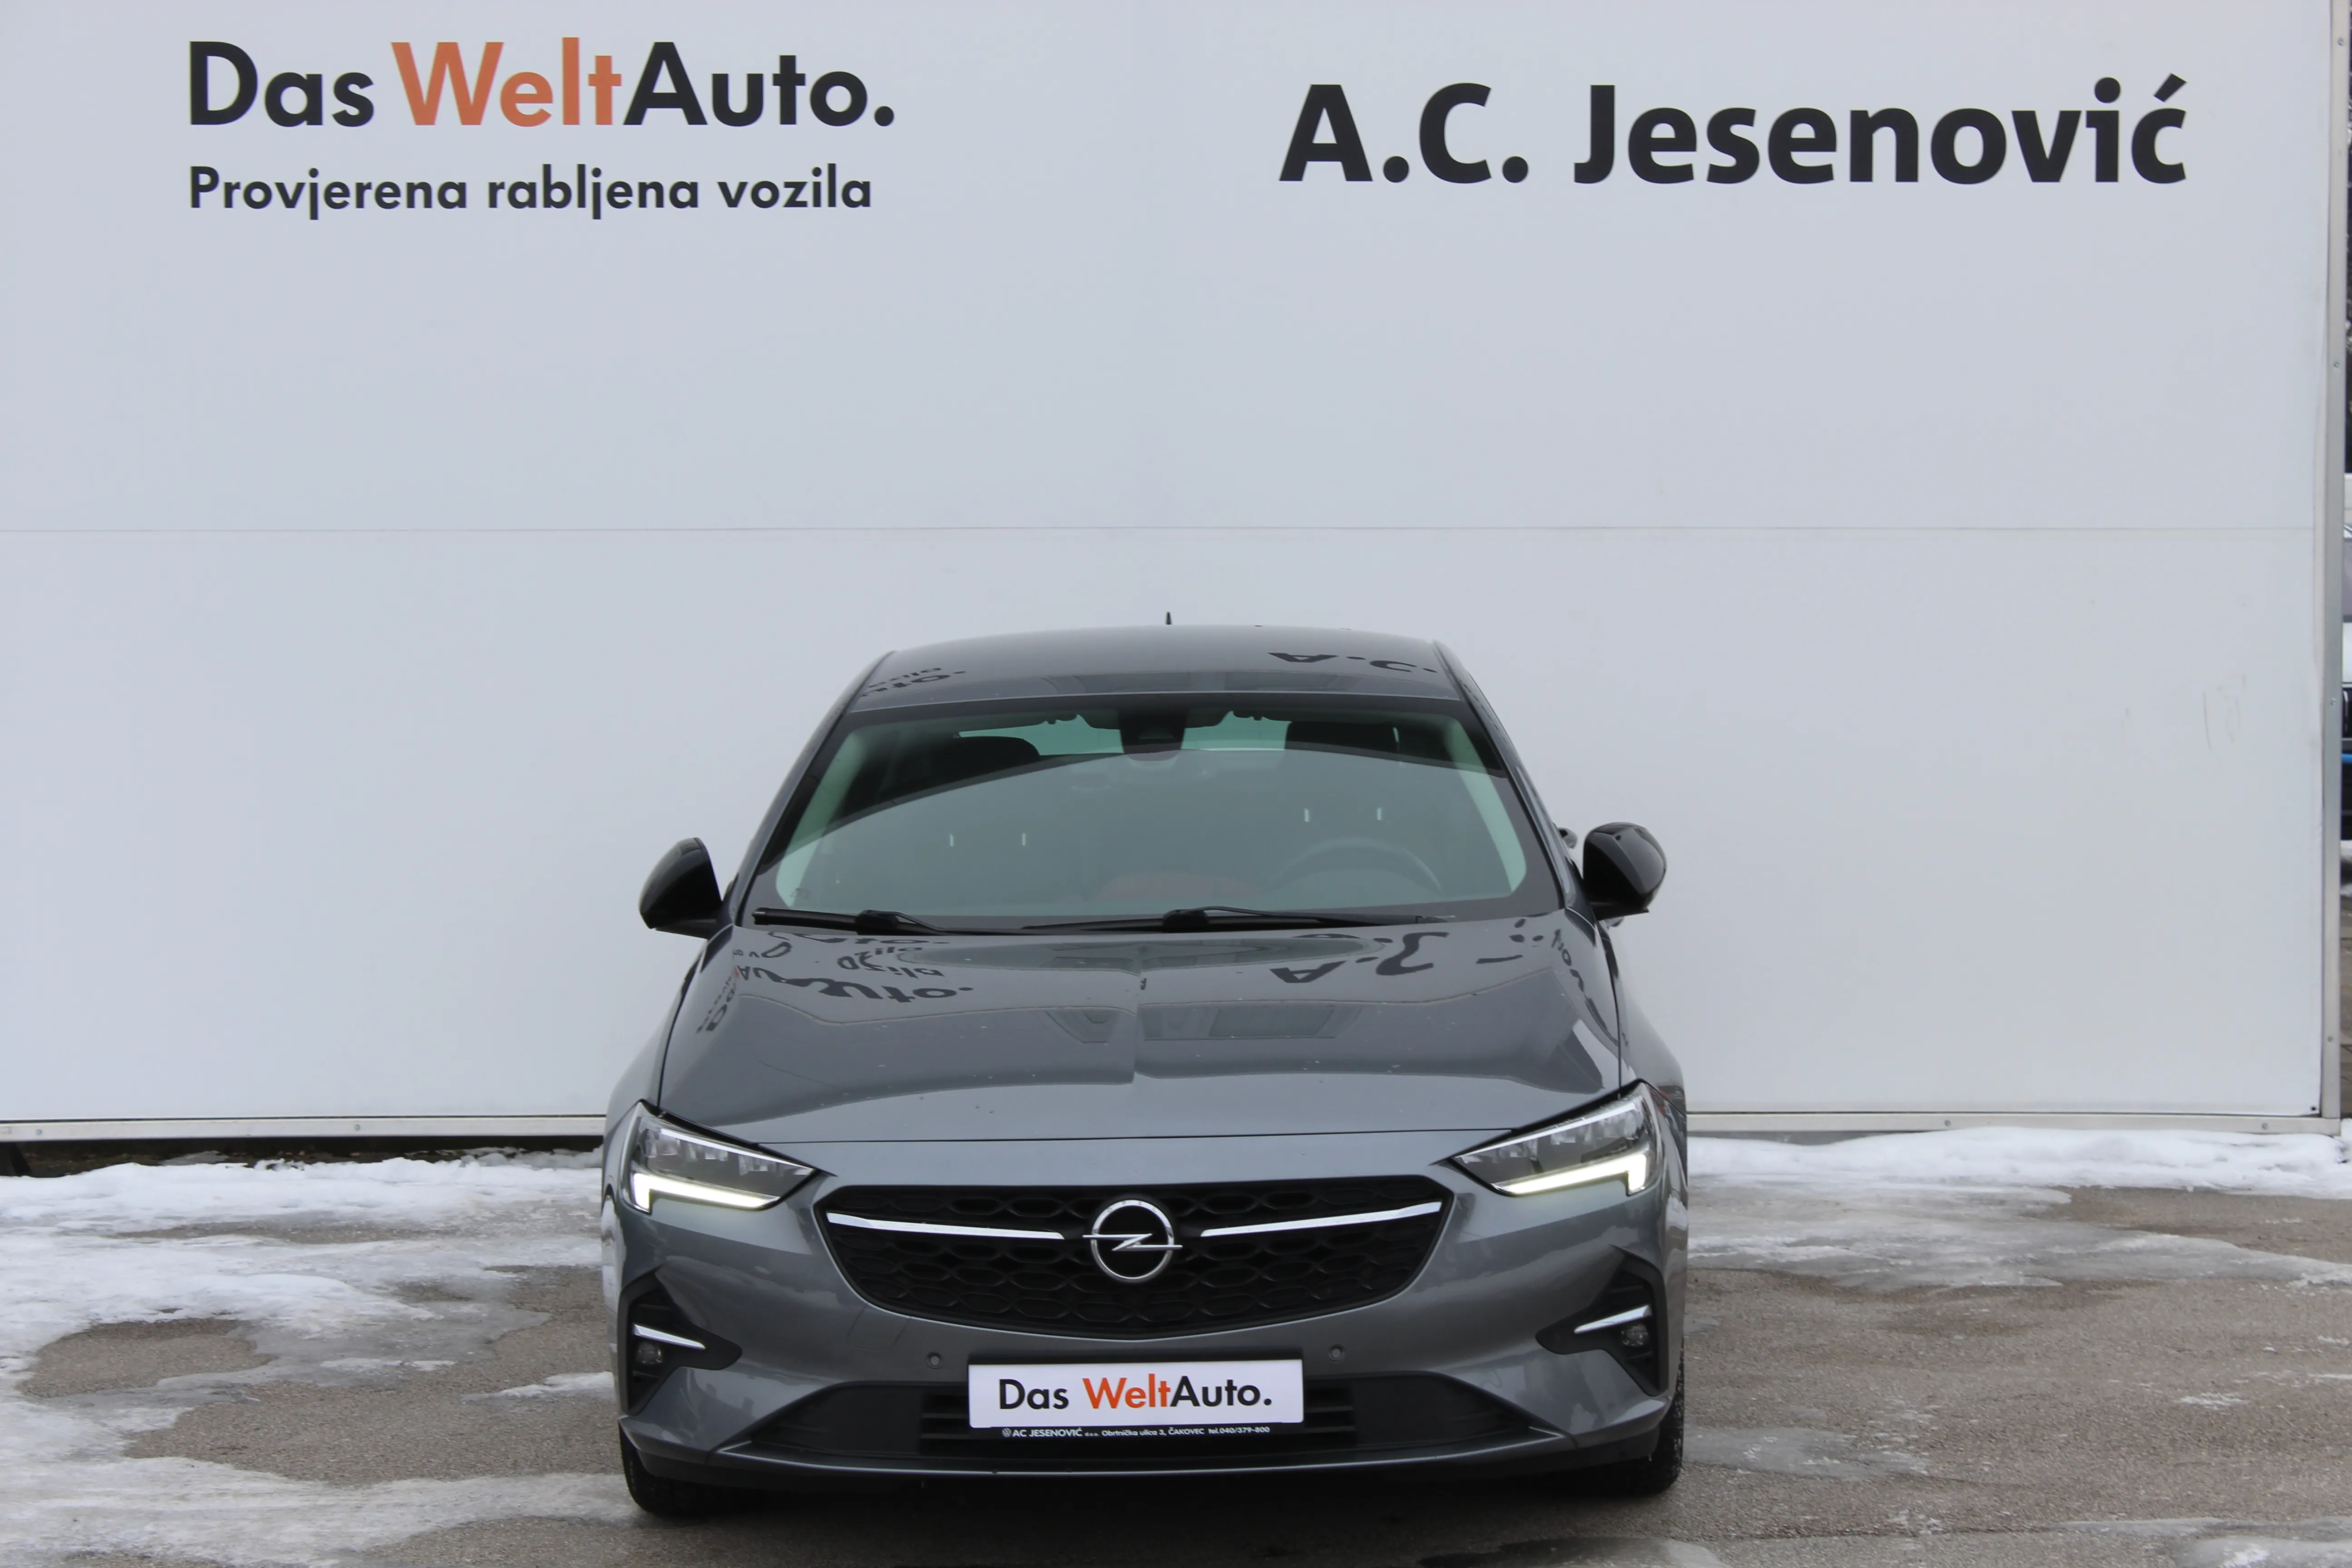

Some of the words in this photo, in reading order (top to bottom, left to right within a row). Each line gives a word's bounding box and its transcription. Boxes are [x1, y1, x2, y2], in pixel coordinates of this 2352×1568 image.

[190, 40, 375, 129] Das
[391, 37, 895, 128] WeltAuto.
[1279, 82, 1529, 184] A.C.
[1574, 73, 2187, 185] Jesenović
[190, 166, 467, 221] Provjerena
[488, 164, 699, 220] rabljena
[717, 163, 872, 210] vozila
[999, 1378, 1070, 1410] Das
[1083, 1373, 1273, 1410] WeltAuto.
[1012, 1429, 1027, 1437] AC
[1029, 1427, 1083, 1437] JESENOVIĆ
[1167, 1426, 1205, 1435] ČAKOVEC
